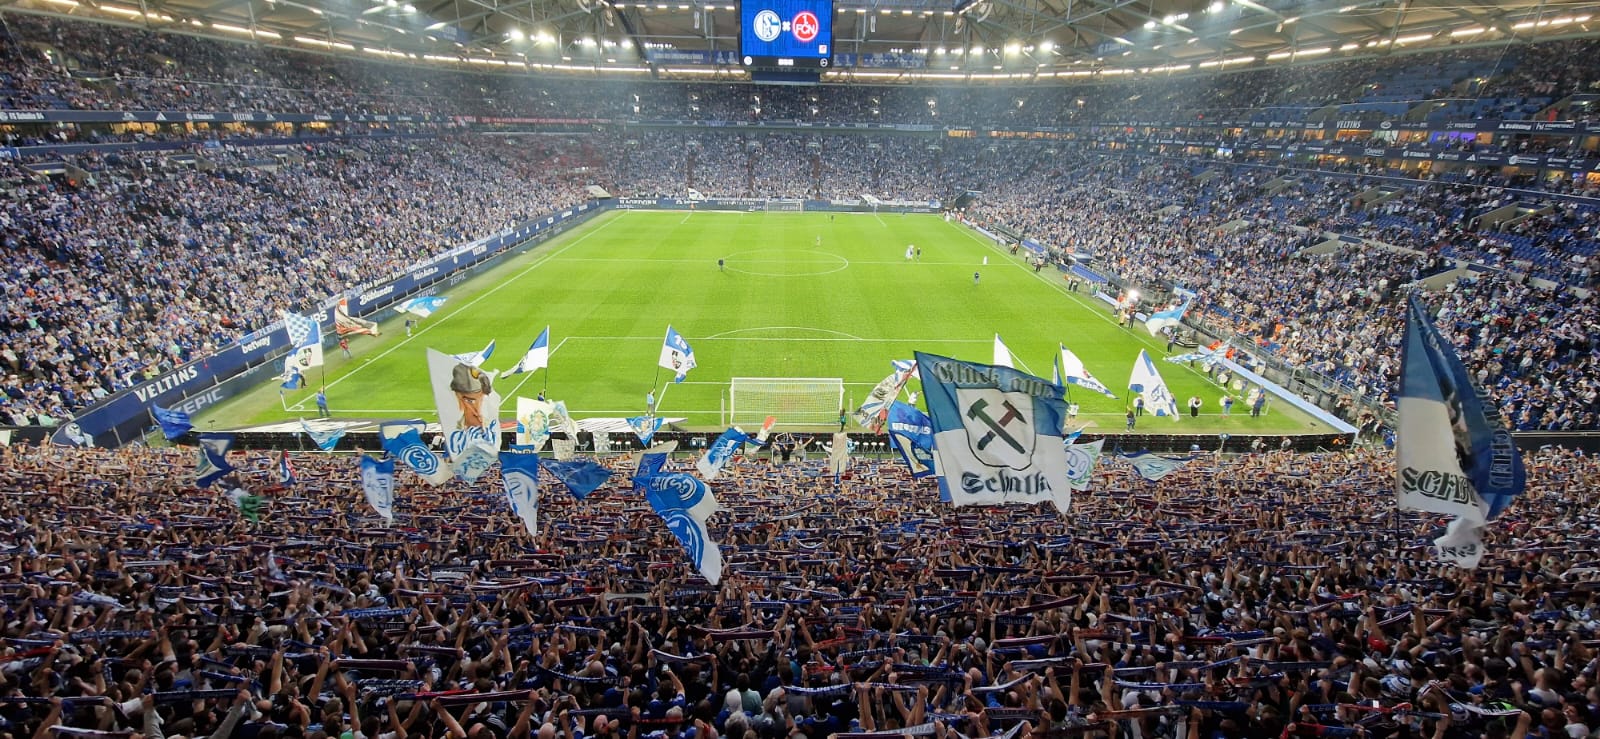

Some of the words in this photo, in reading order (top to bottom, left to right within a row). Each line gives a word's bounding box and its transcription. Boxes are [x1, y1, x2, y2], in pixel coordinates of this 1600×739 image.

[796, 23, 815, 34] FCN
[1336, 120, 1361, 129] VELTINS
[241, 335, 271, 354] betway
[134, 365, 199, 403] VELTINS
